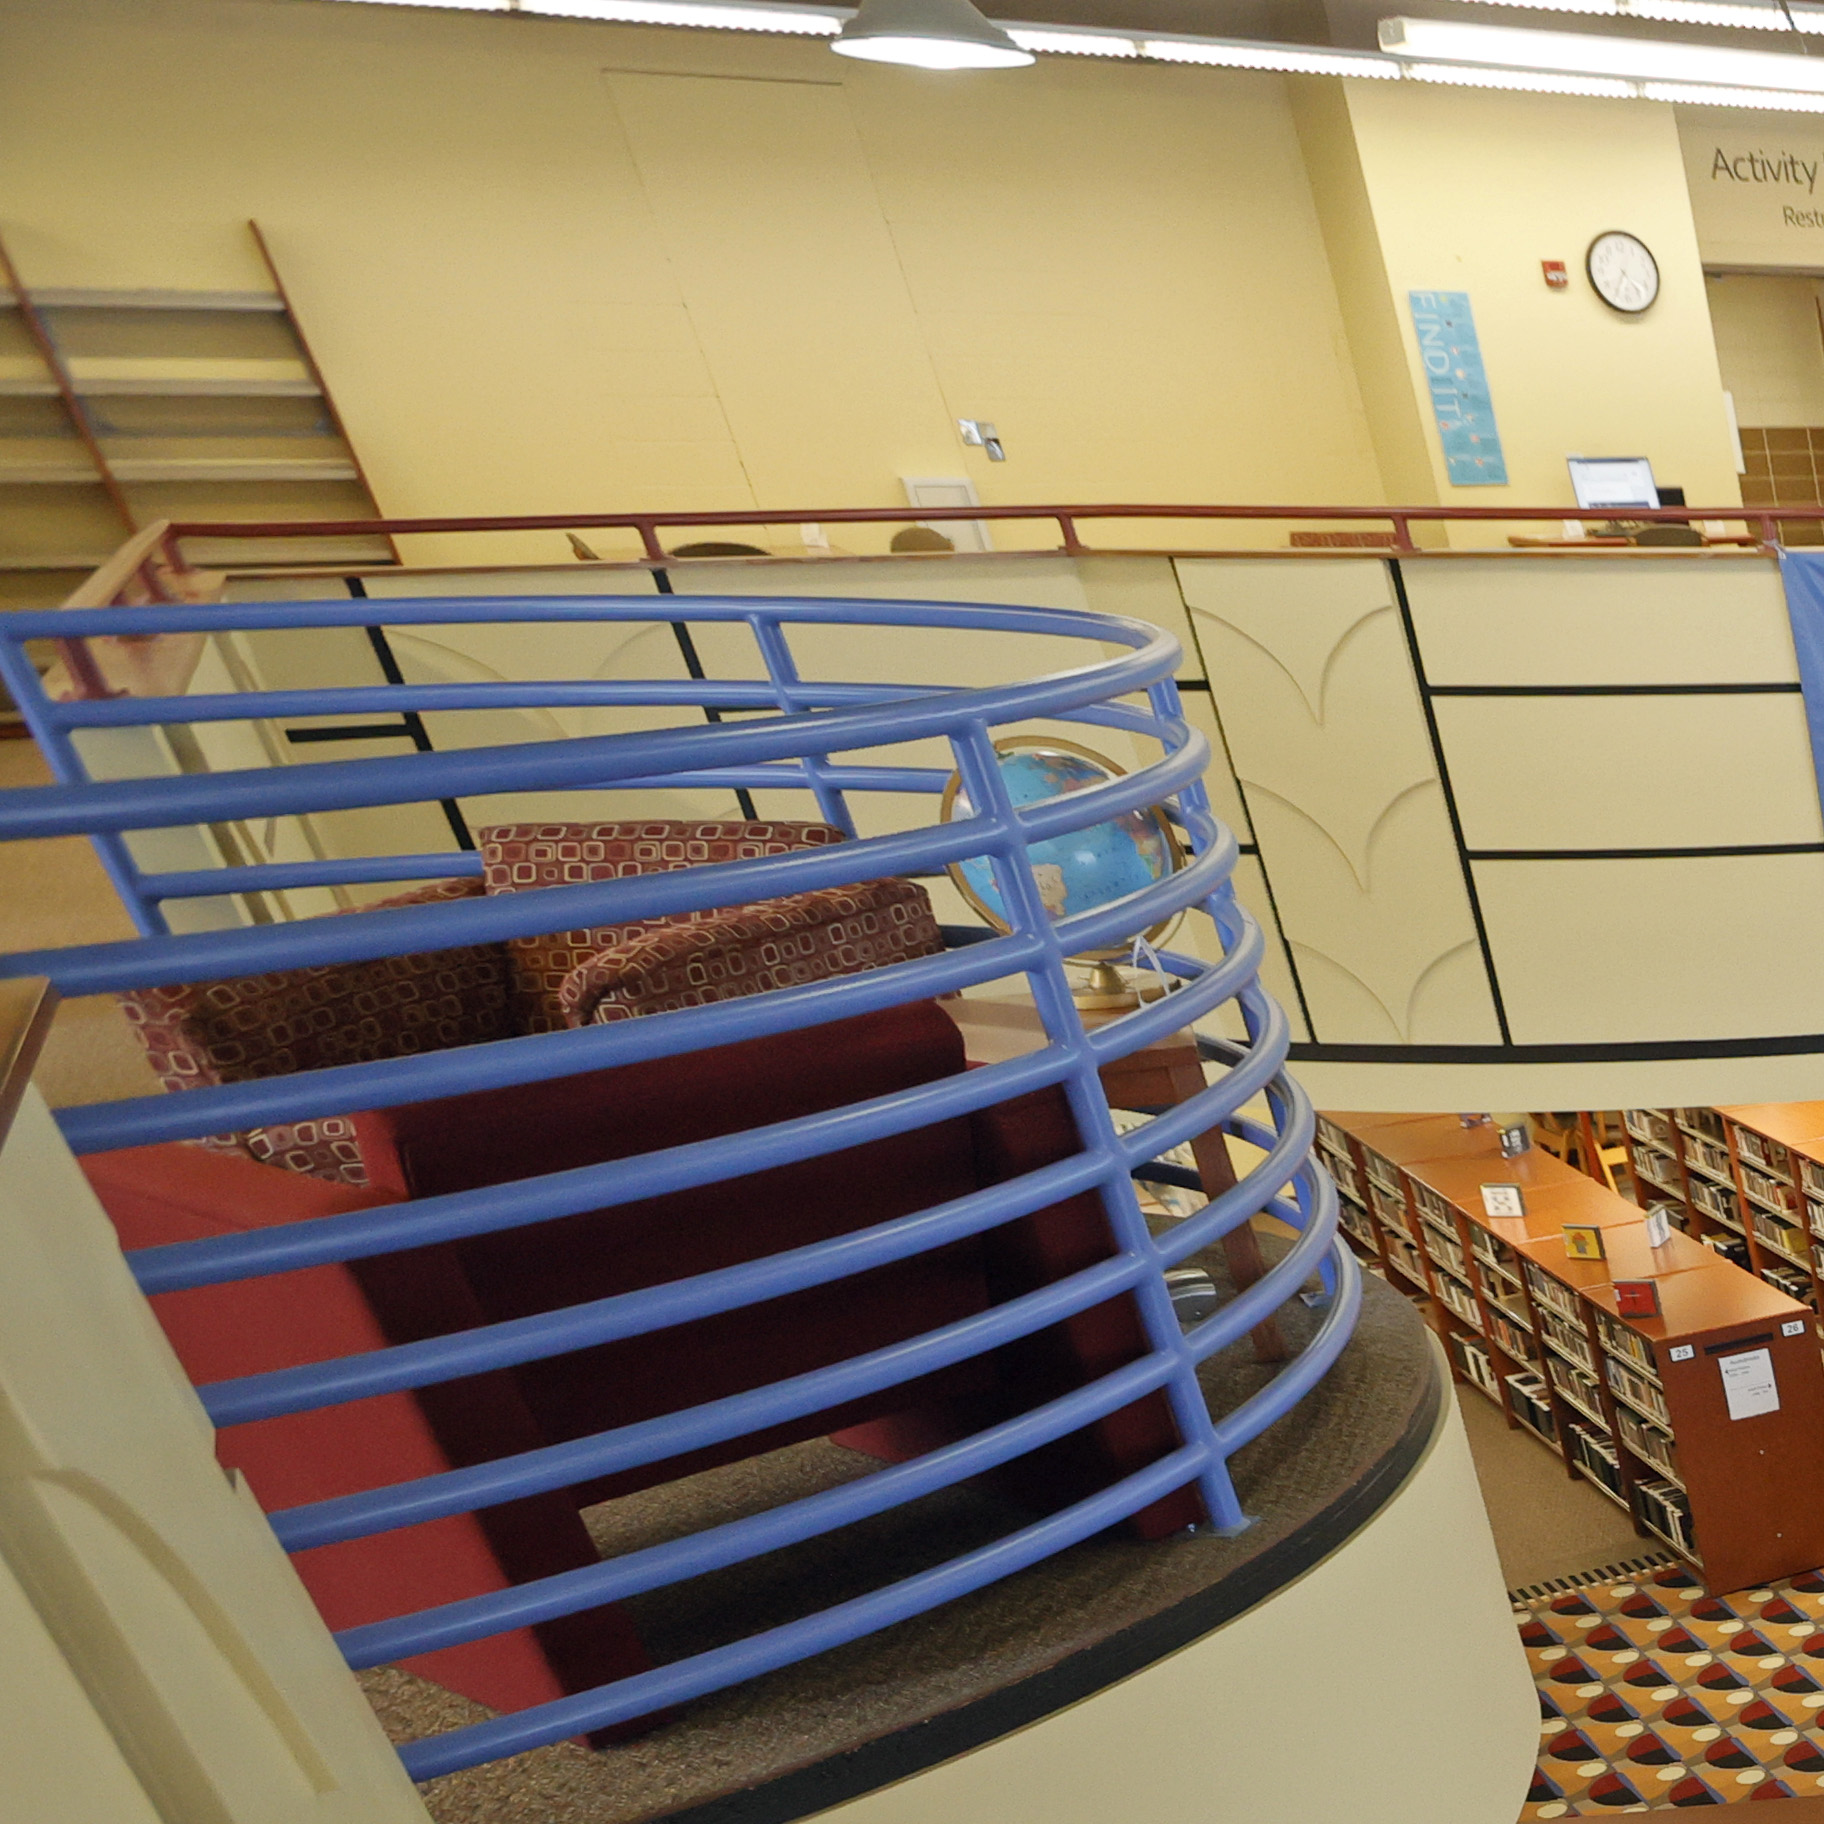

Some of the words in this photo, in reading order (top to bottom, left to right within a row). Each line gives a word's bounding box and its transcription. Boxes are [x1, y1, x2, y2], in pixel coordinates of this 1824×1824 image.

[1711, 147, 1818, 196] Activity
[1787, 1323, 1799, 1334] 26
[1676, 1348, 1689, 1358] 25
